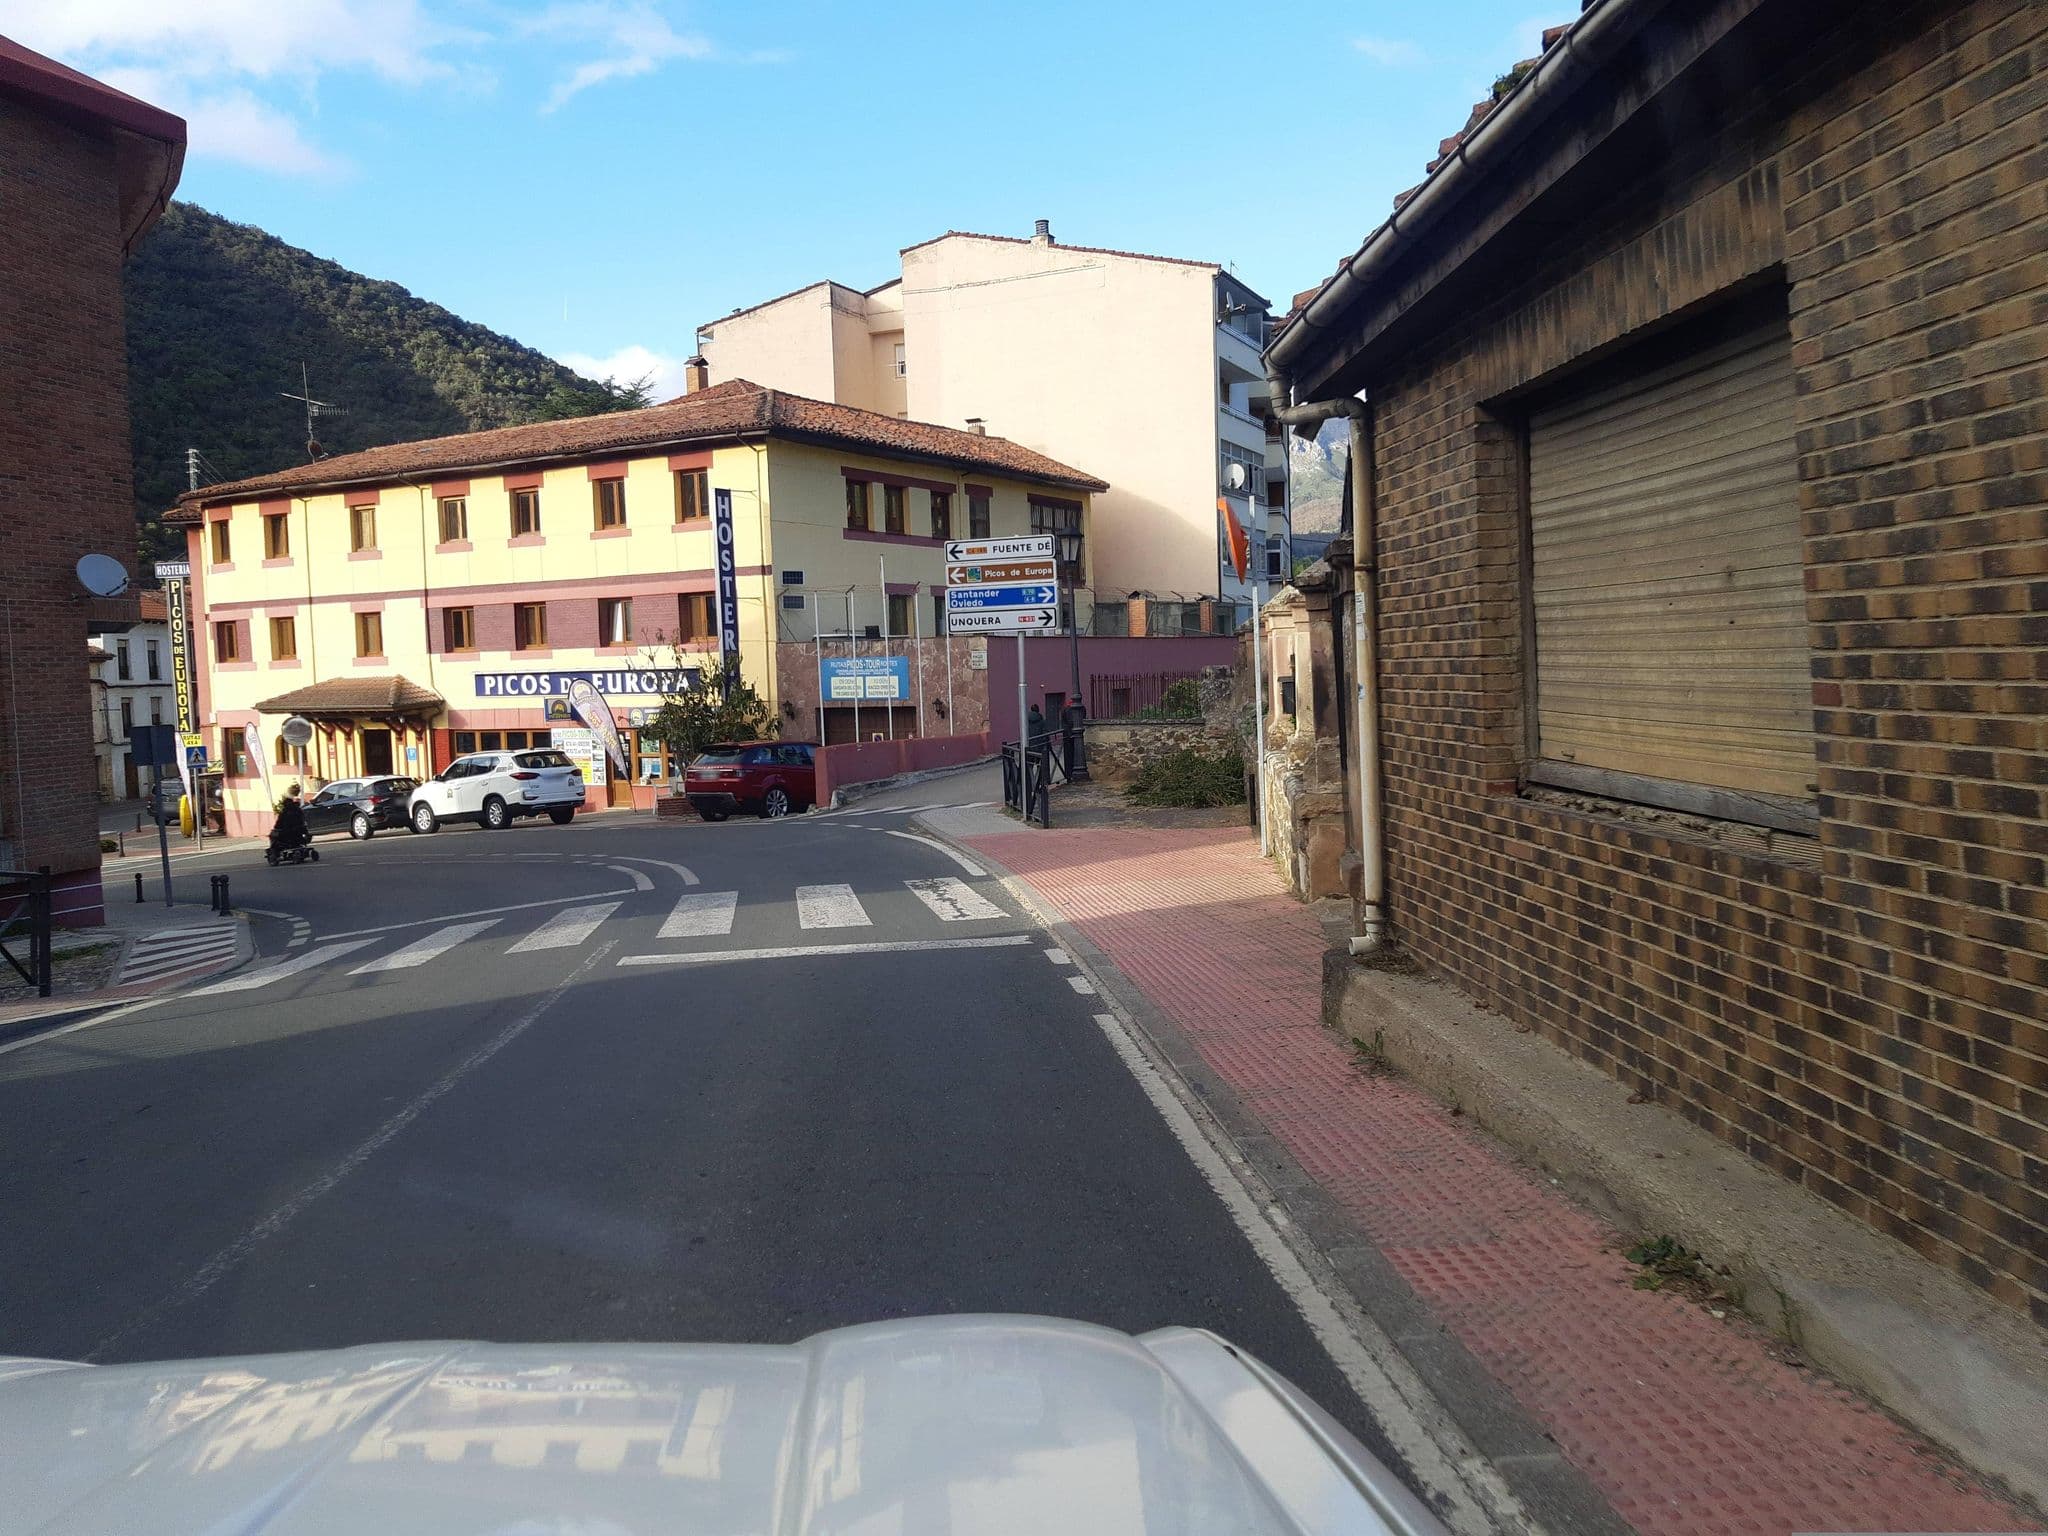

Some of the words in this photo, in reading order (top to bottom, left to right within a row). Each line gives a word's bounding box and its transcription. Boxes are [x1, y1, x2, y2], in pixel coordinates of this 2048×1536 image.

[993, 543, 1032, 553] FUENTE
[1038, 541, 1051, 551] DÉ
[1010, 568, 1020, 576] de
[1025, 567, 1052, 576] Europa
[950, 590, 1000, 599] Santander
[951, 599, 984, 608] Oviedo
[170, 581, 183, 644] PICOS
[951, 616, 1001, 626] UNQUERA
[174, 646, 185, 654] DE
[484, 674, 552, 695] PICOS
[592, 671, 689, 694] EUROPA
[175, 657, 190, 731] EUROPA
